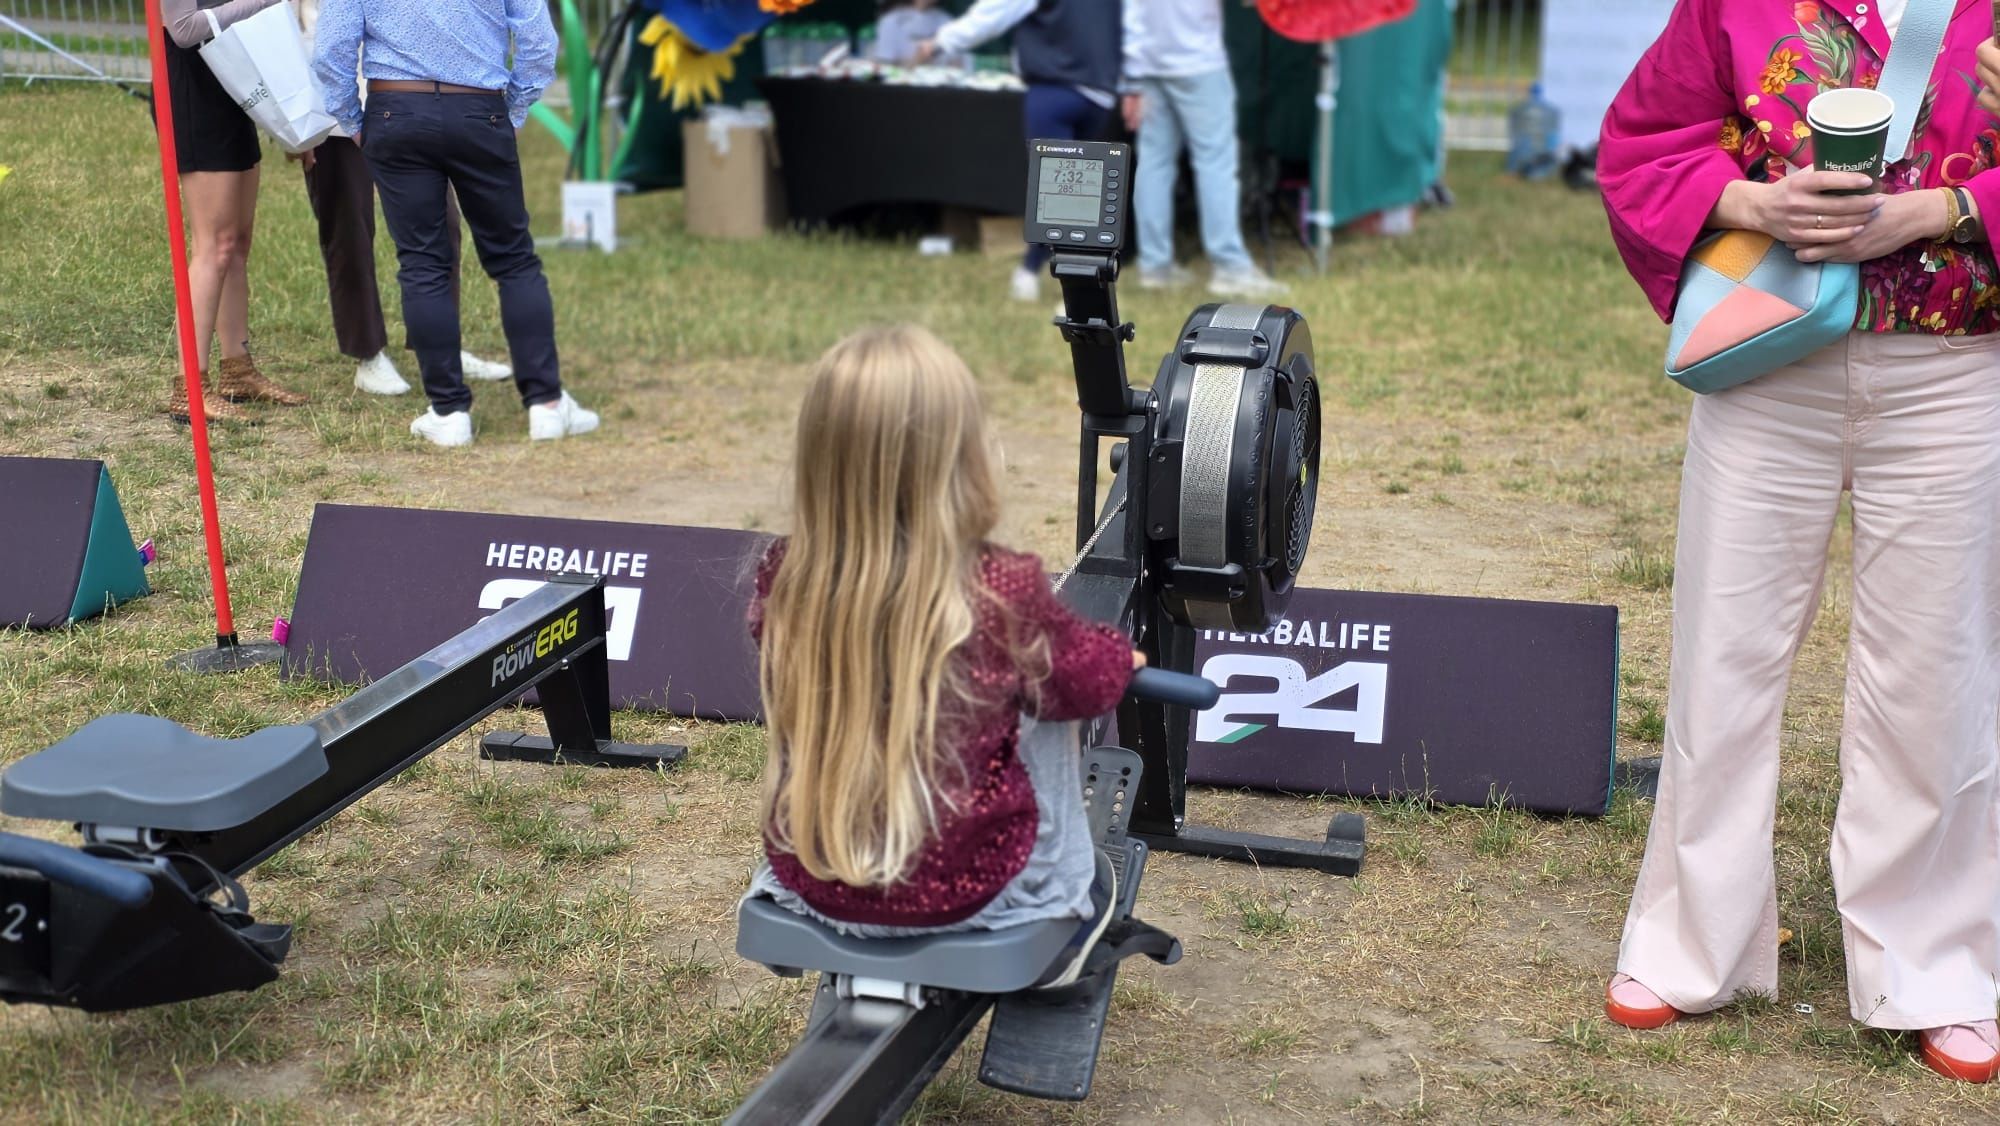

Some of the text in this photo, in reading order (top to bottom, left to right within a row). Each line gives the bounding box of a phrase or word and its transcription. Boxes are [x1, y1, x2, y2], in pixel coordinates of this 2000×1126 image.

[1054, 170, 1084, 184] 7:32
[1825, 160, 1873, 172] Herbalife
[486, 543, 648, 578] HERBALIFE
[1196, 654, 1388, 744] 24
[2, 904, 27, 941] 2
